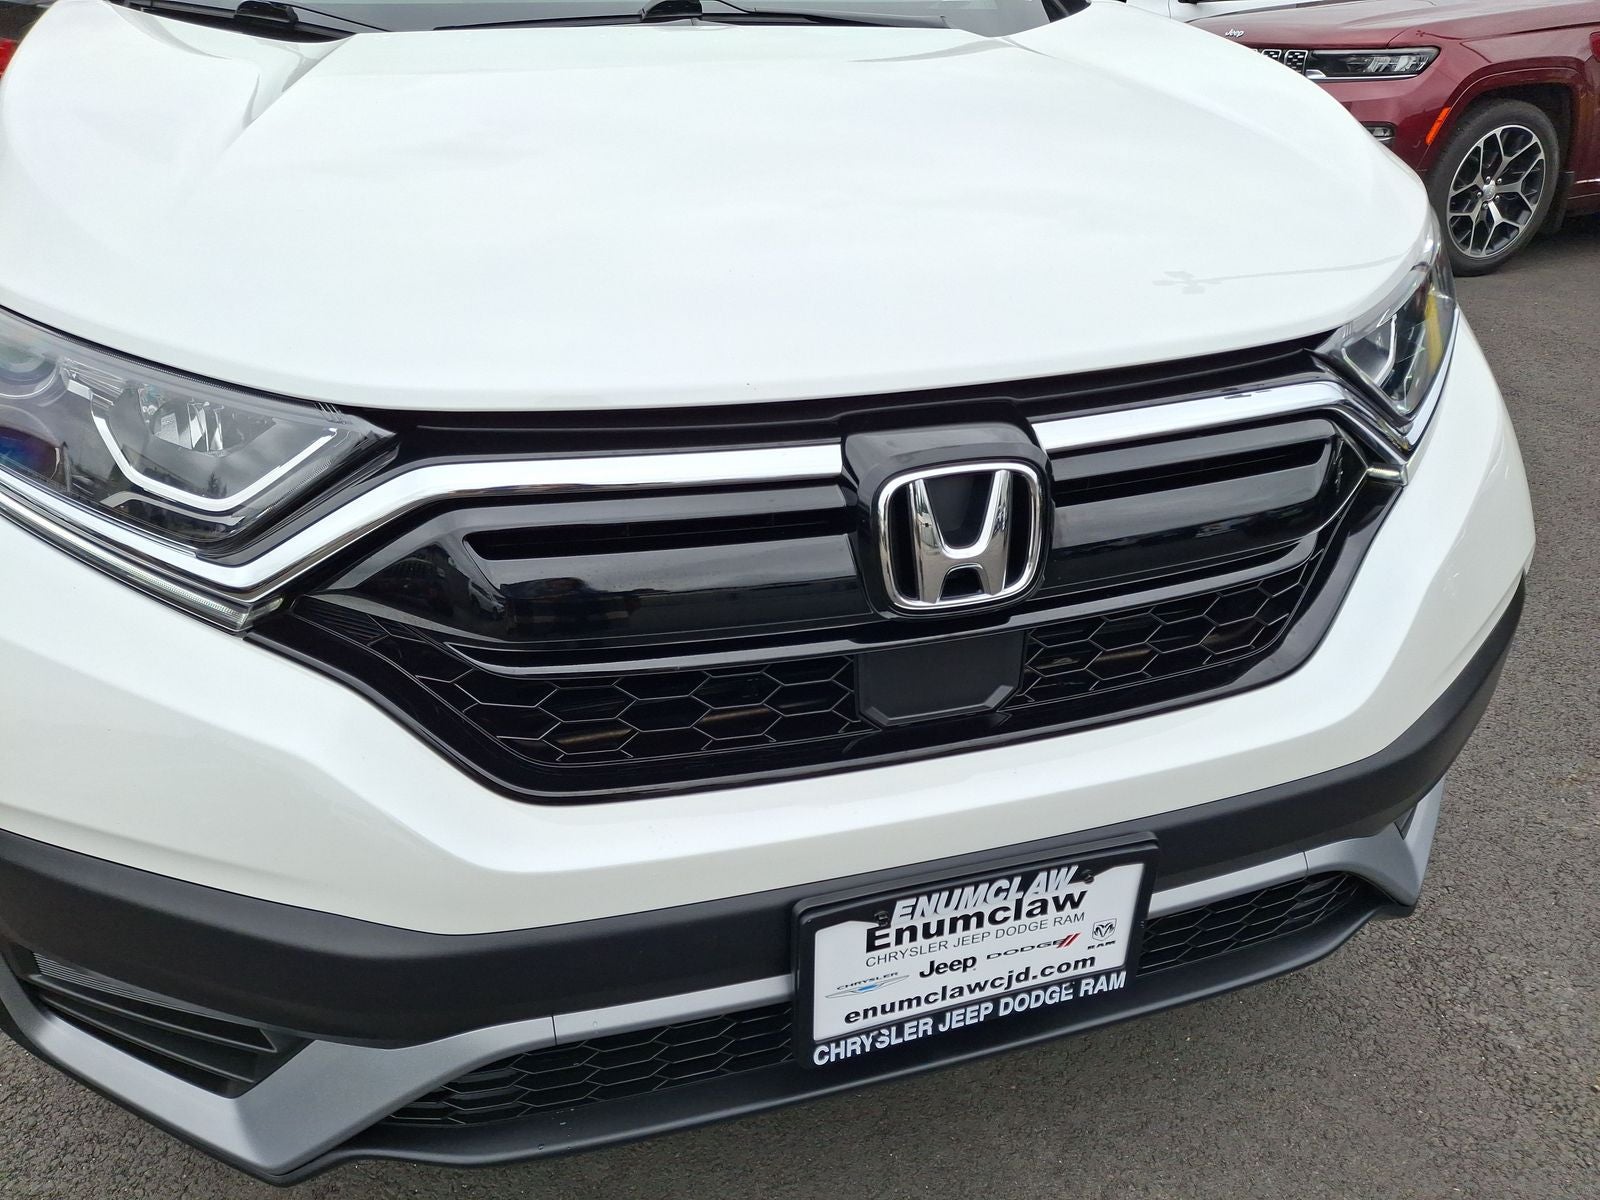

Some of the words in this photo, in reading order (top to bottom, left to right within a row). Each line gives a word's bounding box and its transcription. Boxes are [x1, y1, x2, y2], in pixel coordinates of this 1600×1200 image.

[865, 890, 1088, 953] Enumclaw
[891, 865, 1079, 923] ENUMCLAW
[836, 972, 899, 990] CHRYSLER
[919, 955, 977, 978] Jeep
[986, 938, 1066, 960] DODGE
[865, 940, 948, 968] CHRYSLER
[953, 932, 991, 948] JEEP
[995, 919, 1048, 939] DODGE
[1053, 912, 1085, 927] RAM
[813, 1017, 933, 1066] CHRYSLER
[938, 1002, 994, 1033] JEEP
[999, 983, 1074, 1017] DODGE
[1079, 971, 1127, 997] RAM
[844, 956, 1096, 1024] enumclawcjd.com
